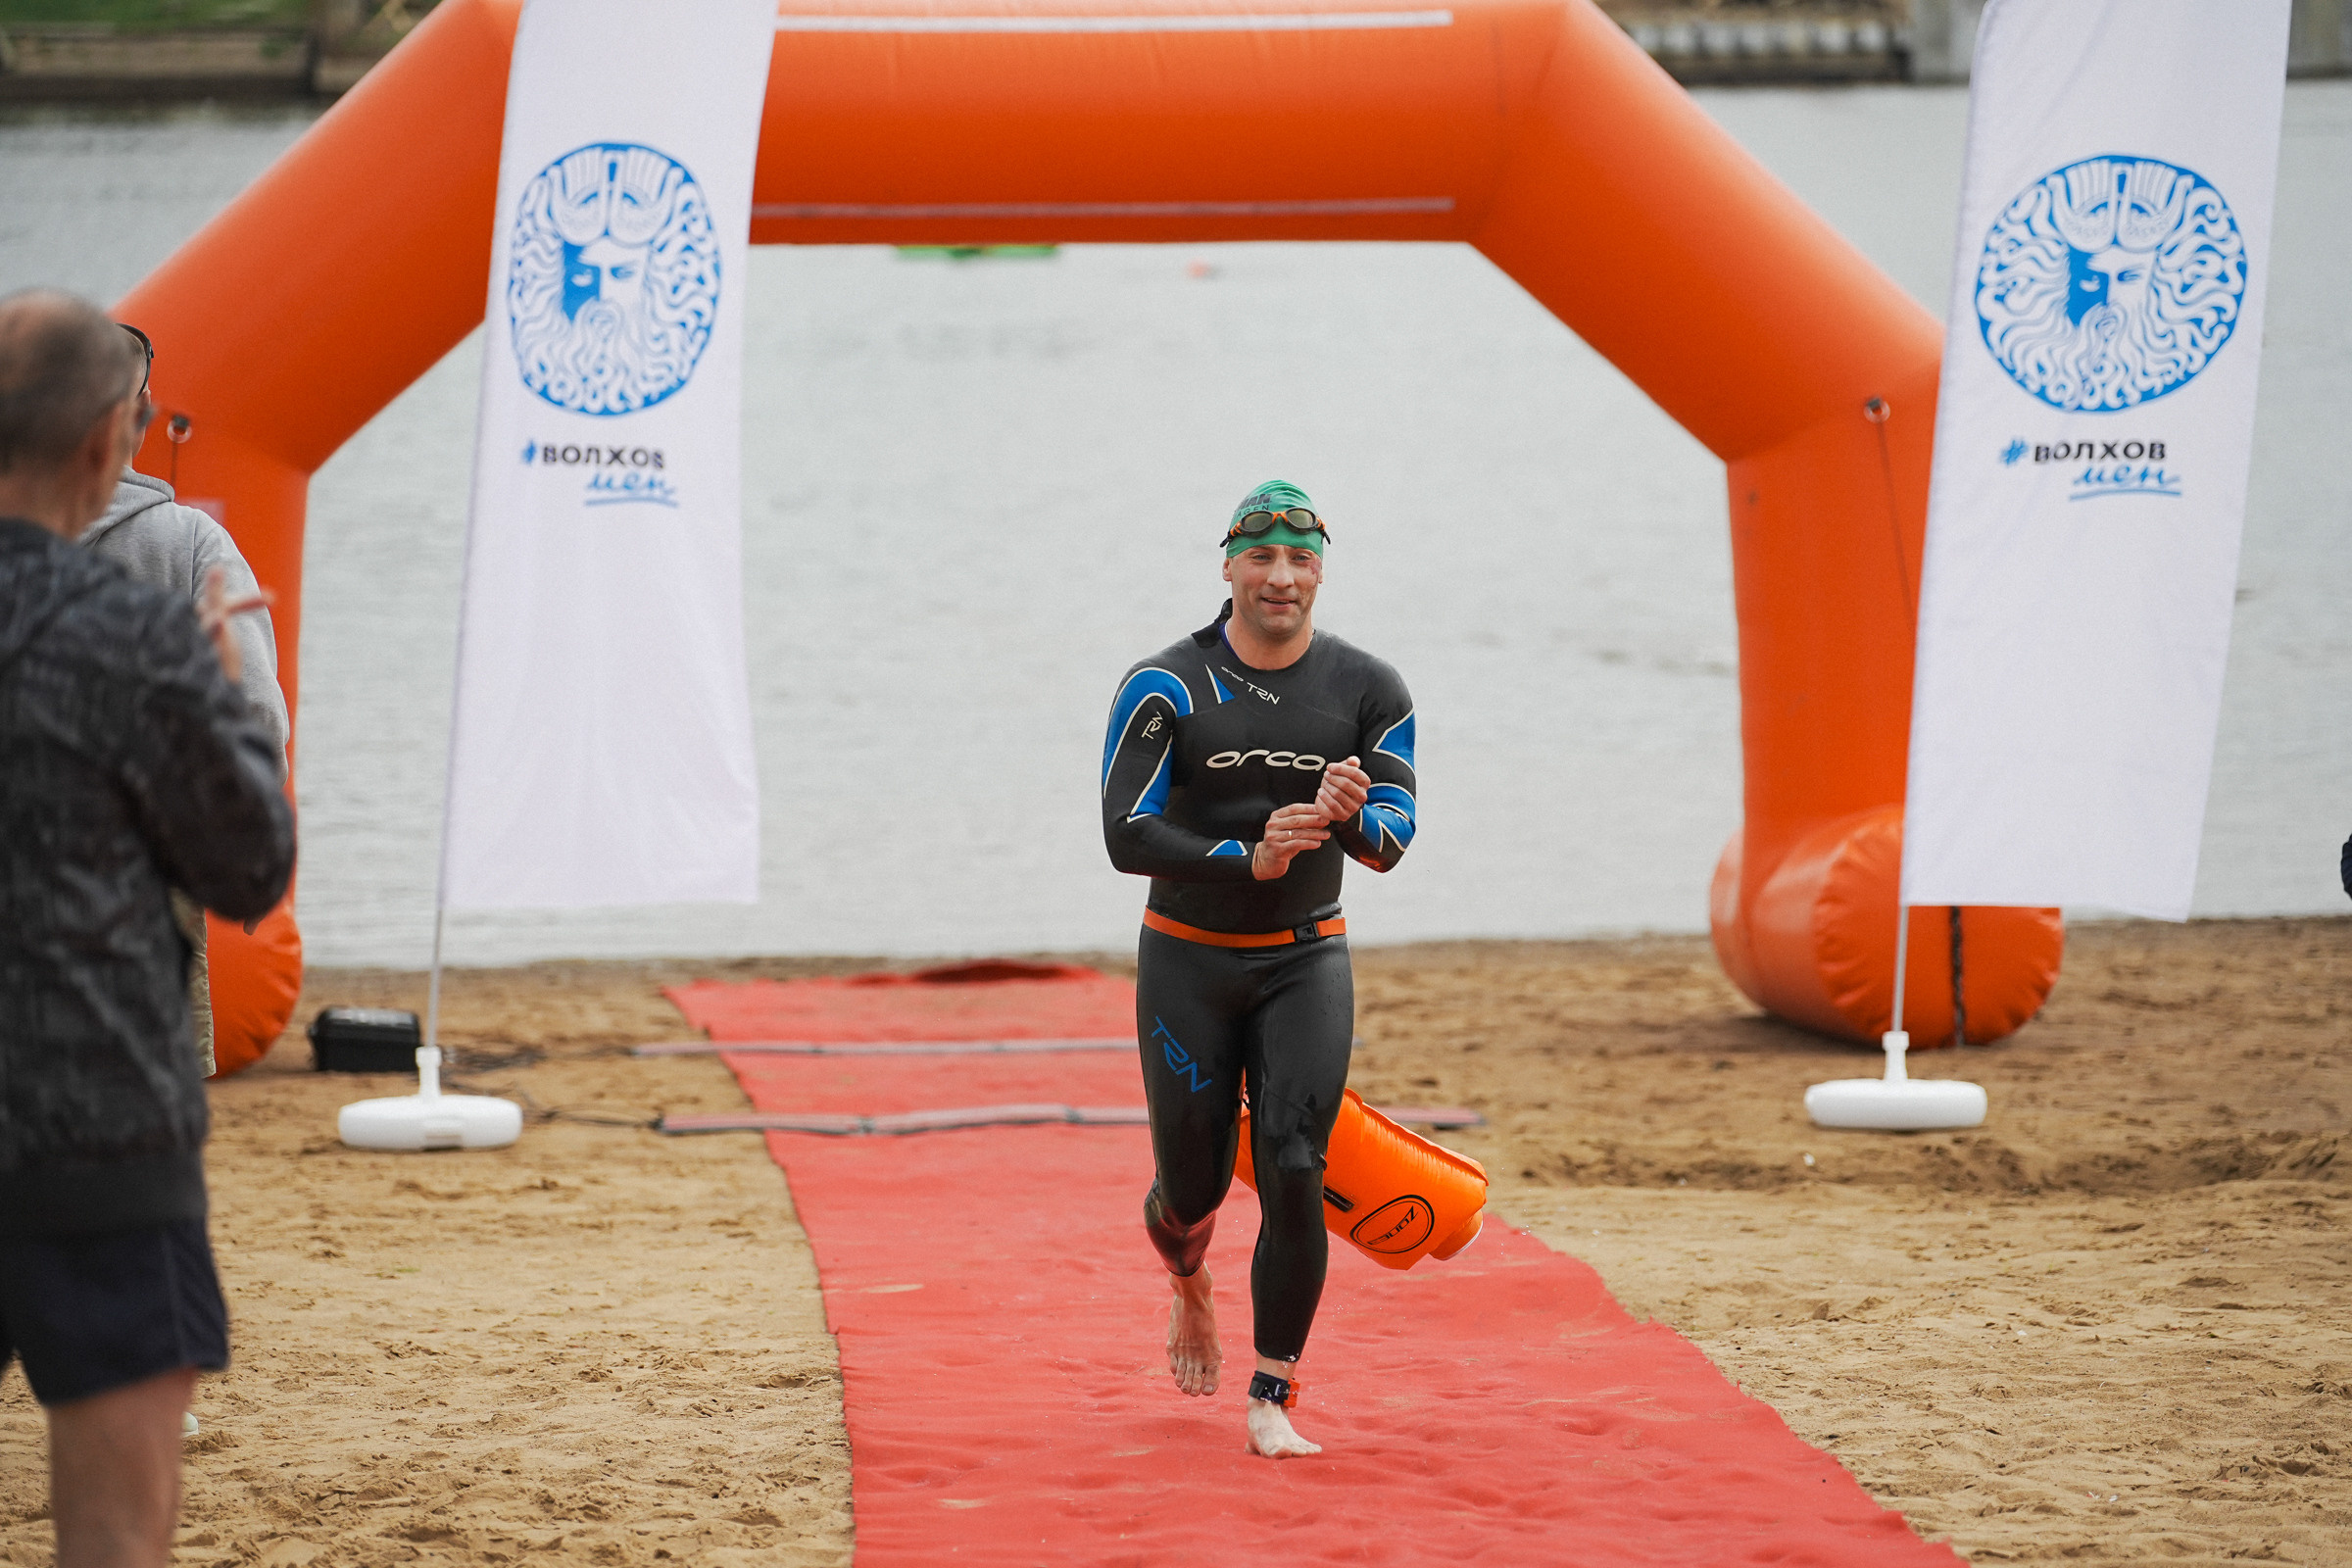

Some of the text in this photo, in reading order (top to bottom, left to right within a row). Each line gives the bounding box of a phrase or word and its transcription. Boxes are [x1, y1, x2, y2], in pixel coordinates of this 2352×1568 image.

[2002, 439, 2166, 465] #ВОЛХОВ
[1247, 682, 1281, 705] TRN
[1205, 749, 1326, 771] orca
[1151, 1015, 1212, 1093] TRN
